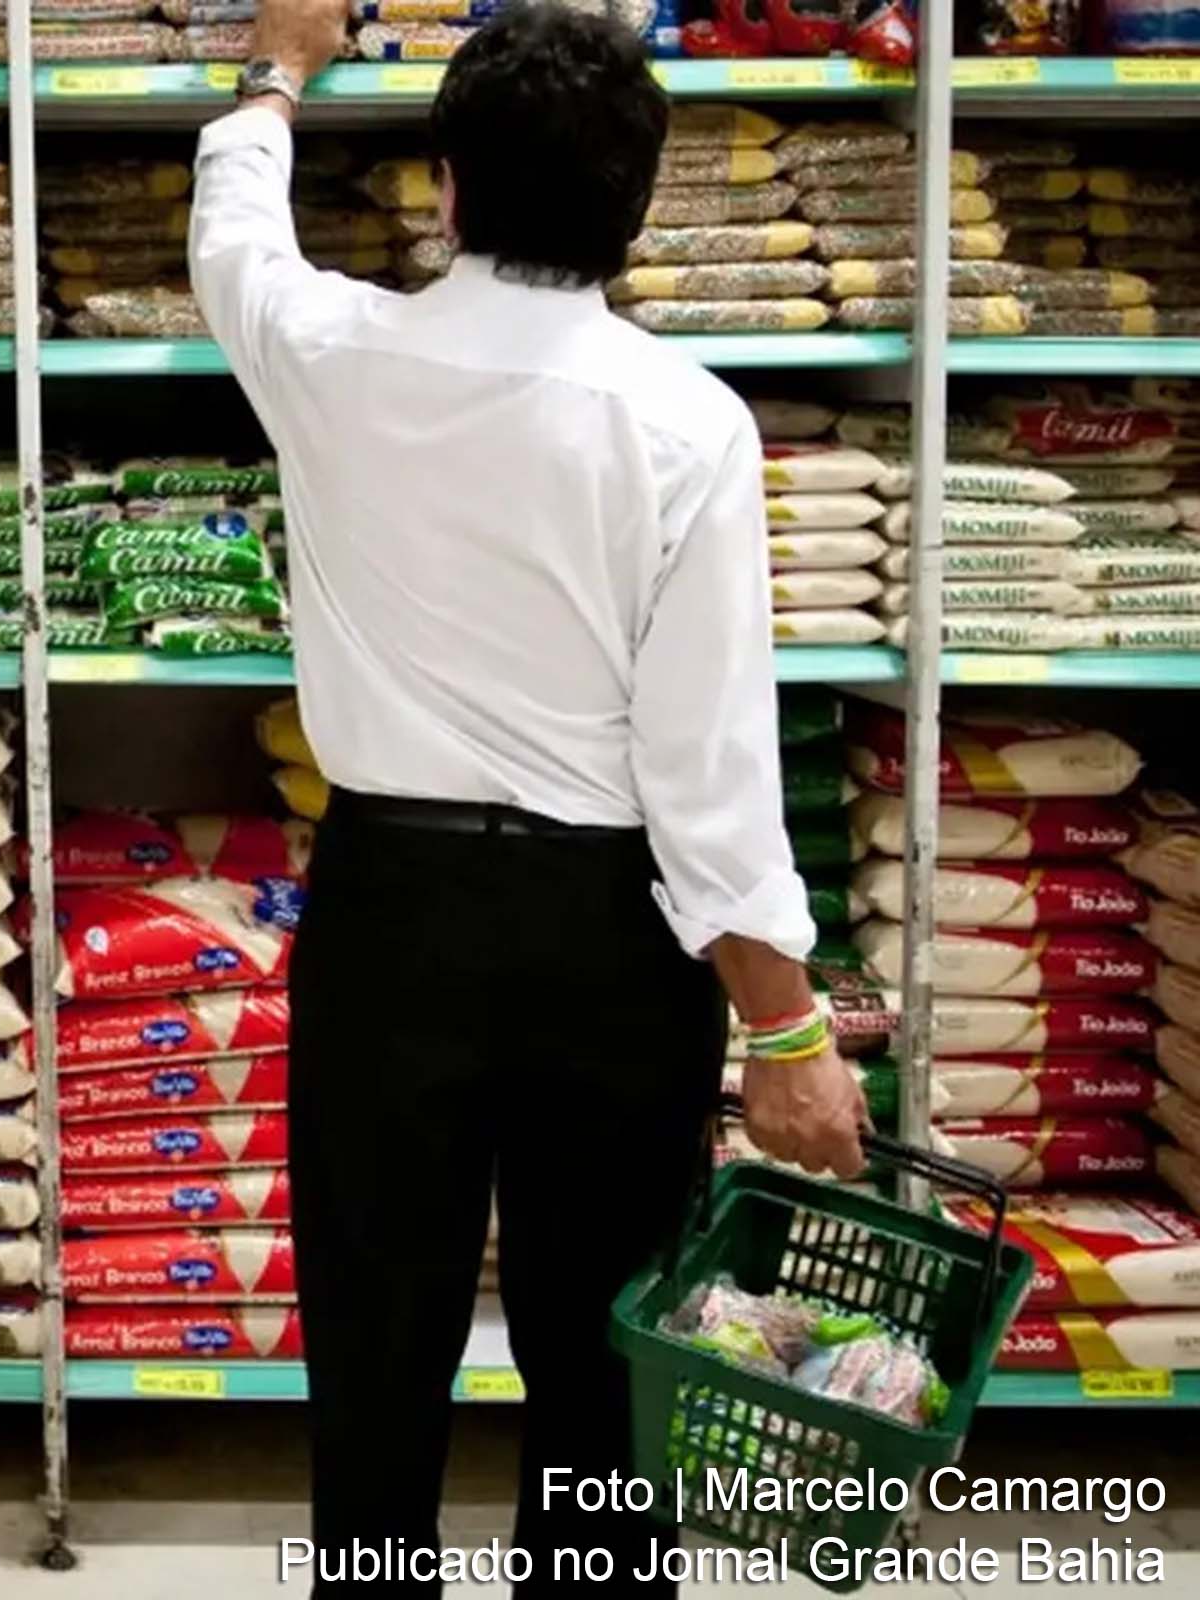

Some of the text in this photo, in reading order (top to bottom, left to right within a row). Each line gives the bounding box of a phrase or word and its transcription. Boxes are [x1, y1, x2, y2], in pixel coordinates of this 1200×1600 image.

[1041, 410, 1136, 443] Camil
[153, 470, 263, 495] Camil
[109, 550, 229, 574] Camil
